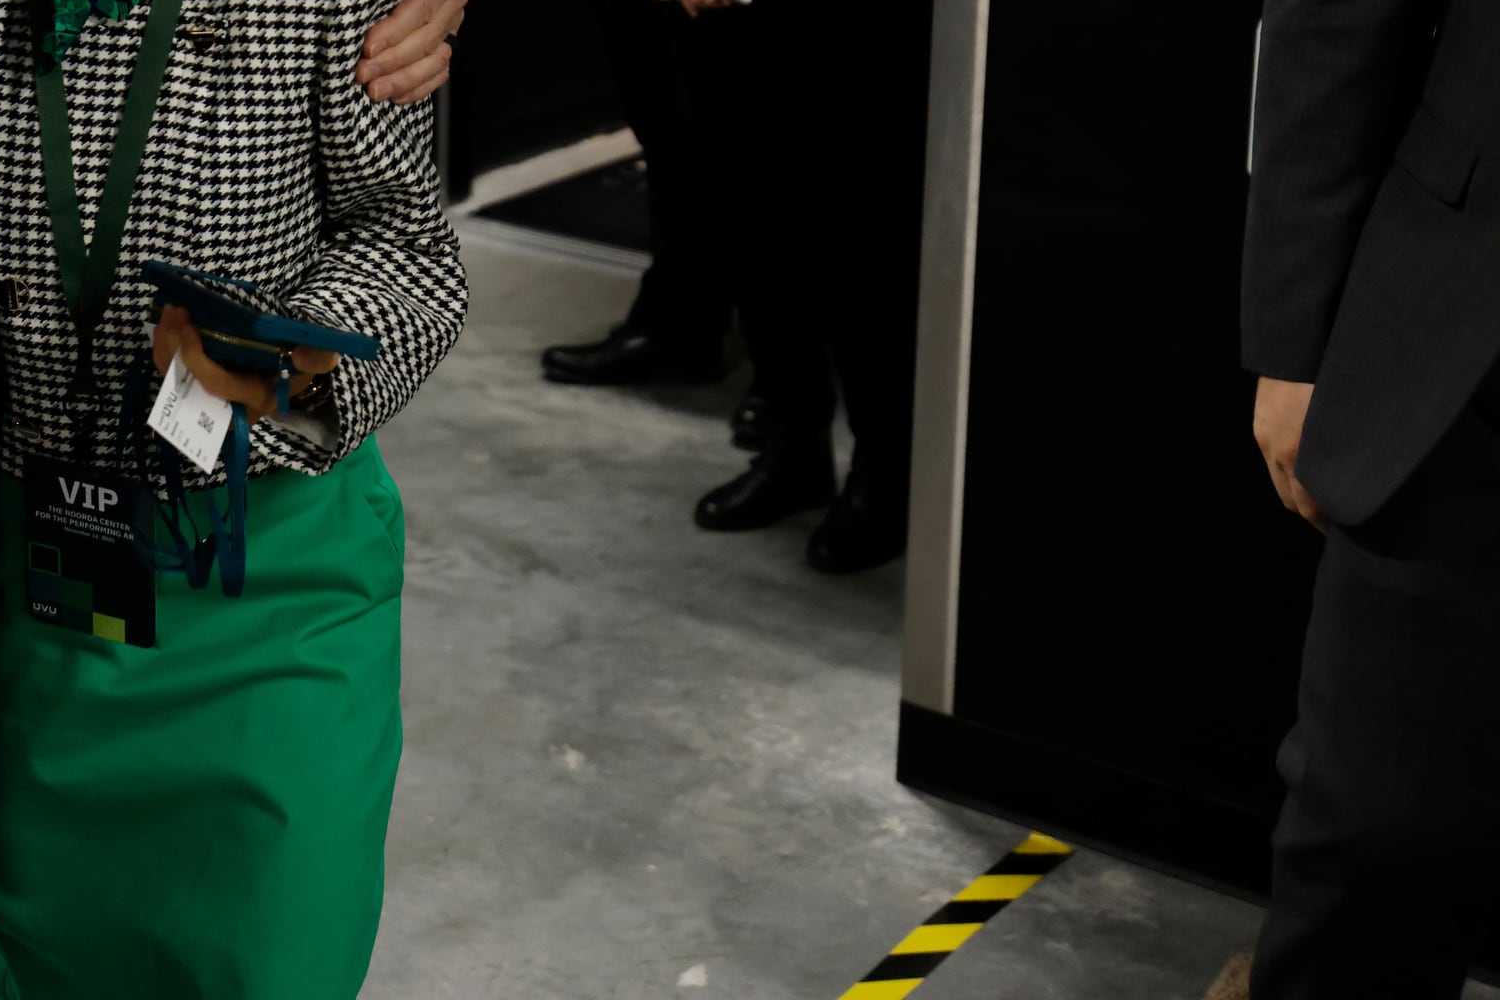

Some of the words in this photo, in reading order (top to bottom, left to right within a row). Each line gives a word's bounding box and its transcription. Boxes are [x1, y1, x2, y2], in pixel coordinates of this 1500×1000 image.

[58, 476, 118, 512] VIP
[35, 510, 51, 520] FOR
[53, 515, 67, 524] THE
[69, 518, 121, 538] PERFORMING
[48, 505, 62, 515] THE
[65, 509, 98, 523] NOORDA
[100, 518, 130, 531] CENTER
